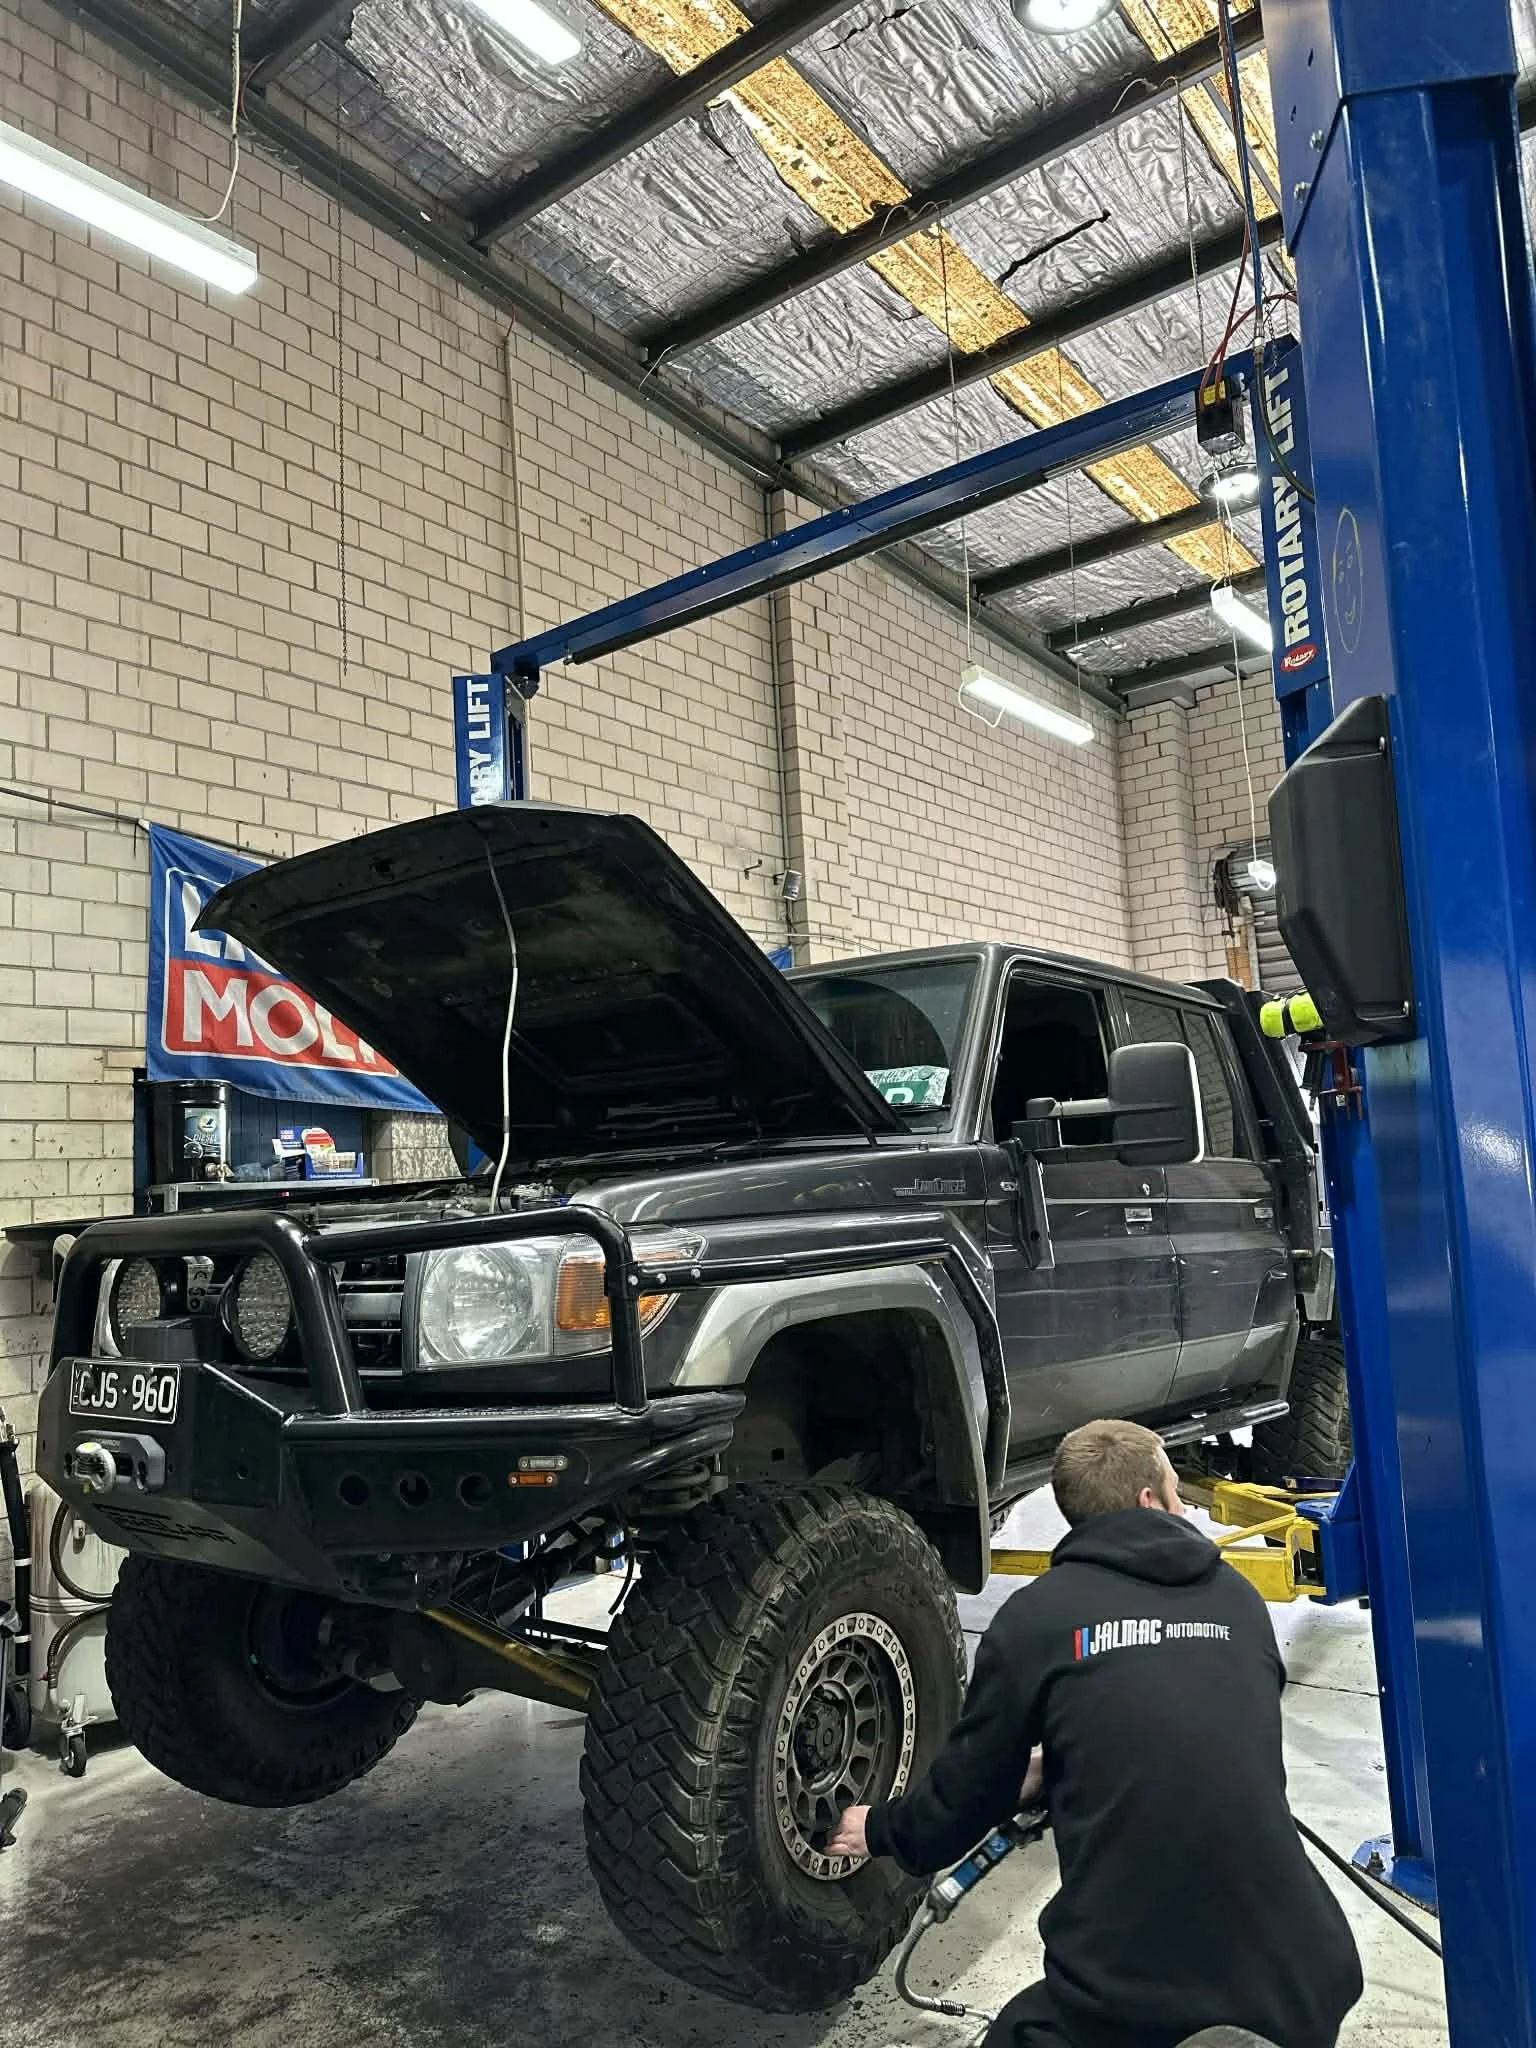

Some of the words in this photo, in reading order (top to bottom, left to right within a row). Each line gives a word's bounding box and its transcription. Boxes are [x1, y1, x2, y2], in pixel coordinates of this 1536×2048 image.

[1264, 368, 1294, 462] LIFT
[1272, 471, 1310, 648] ROTARY
[466, 680, 491, 739] LIFT
[1090, 1619, 1162, 1655] JALMAC
[1165, 1622, 1231, 1641] AUTOMOTIVE
